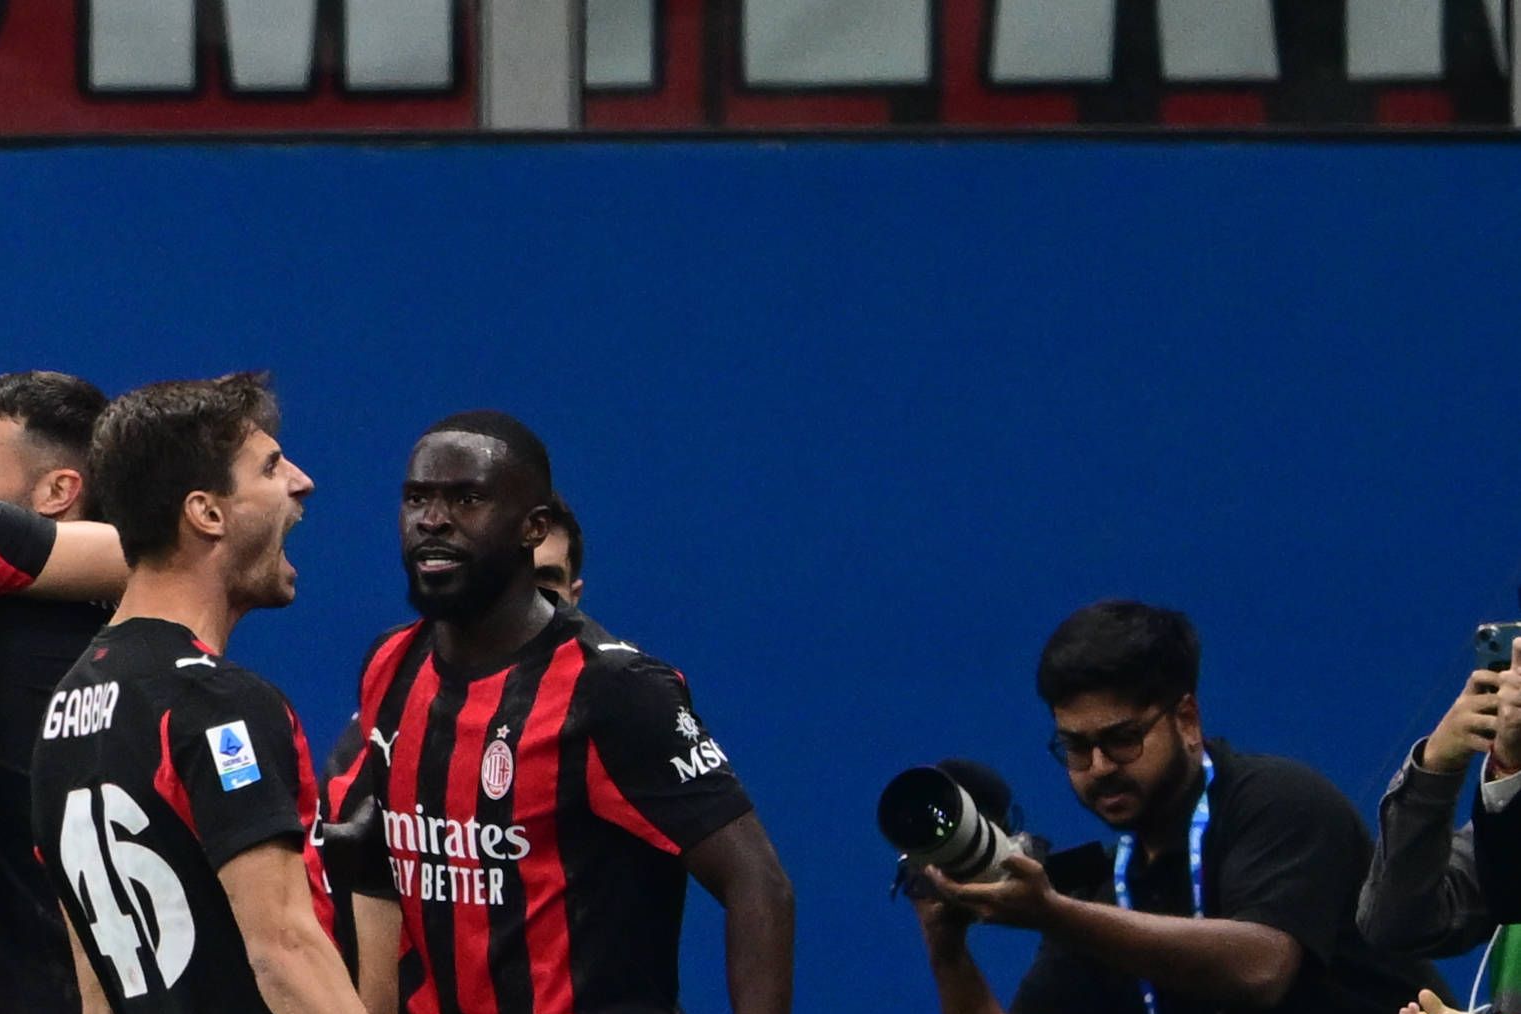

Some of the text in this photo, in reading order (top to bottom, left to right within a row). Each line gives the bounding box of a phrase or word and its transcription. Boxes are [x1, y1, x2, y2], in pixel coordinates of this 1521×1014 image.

[380, 802, 531, 861] mirates
[60, 783, 196, 999] 46
[421, 862, 504, 905] BETTER
